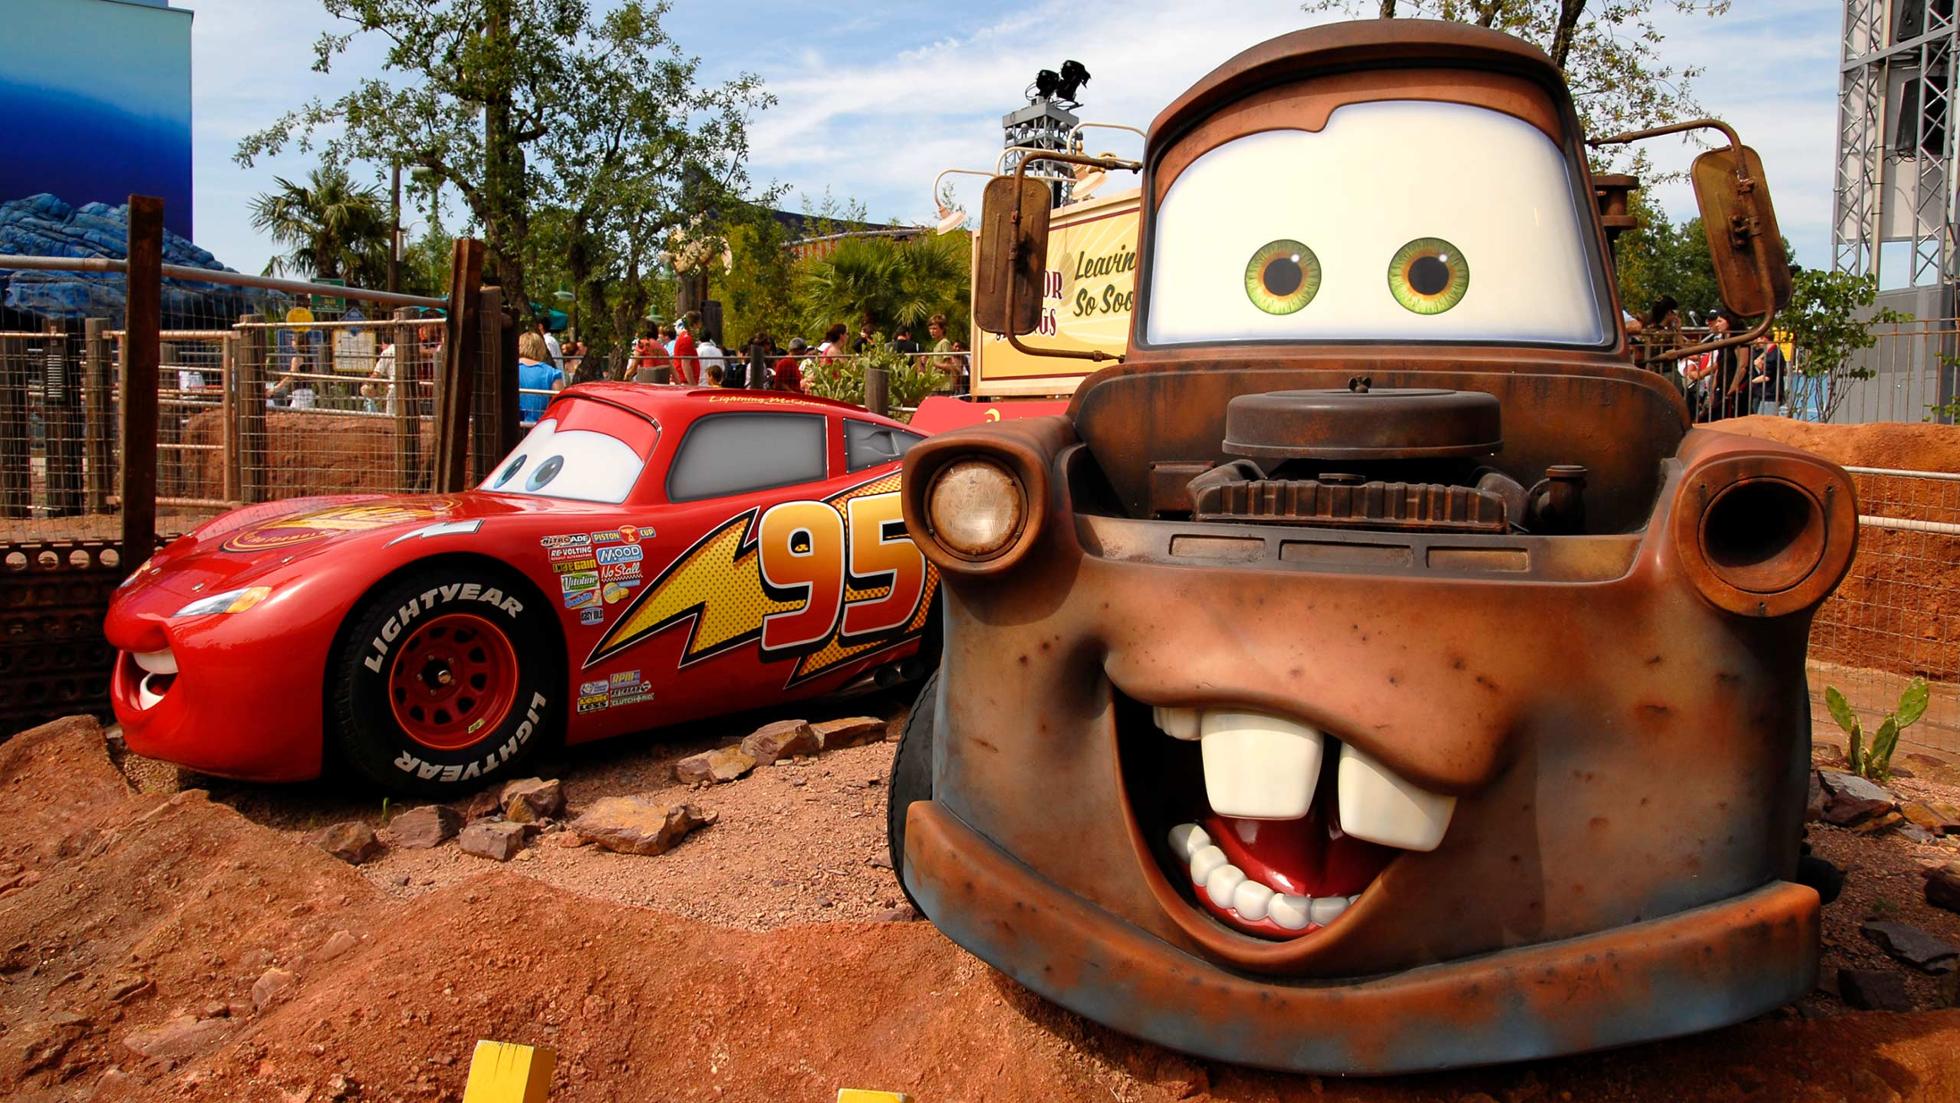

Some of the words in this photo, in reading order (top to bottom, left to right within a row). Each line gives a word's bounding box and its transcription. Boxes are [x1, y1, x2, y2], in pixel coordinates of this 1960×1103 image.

[1074, 244, 1136, 281] Leavin
[1073, 287, 1098, 318] So
[1100, 284, 1134, 314] Soo
[593, 532, 620, 541] PISTON
[640, 528, 654, 537] CUP
[601, 565, 614, 579] No
[614, 562, 640, 577] Stall
[758, 491, 926, 650] 95
[364, 583, 523, 674] LIGHTYEAR
[394, 692, 547, 782] LIGHTYEAR
